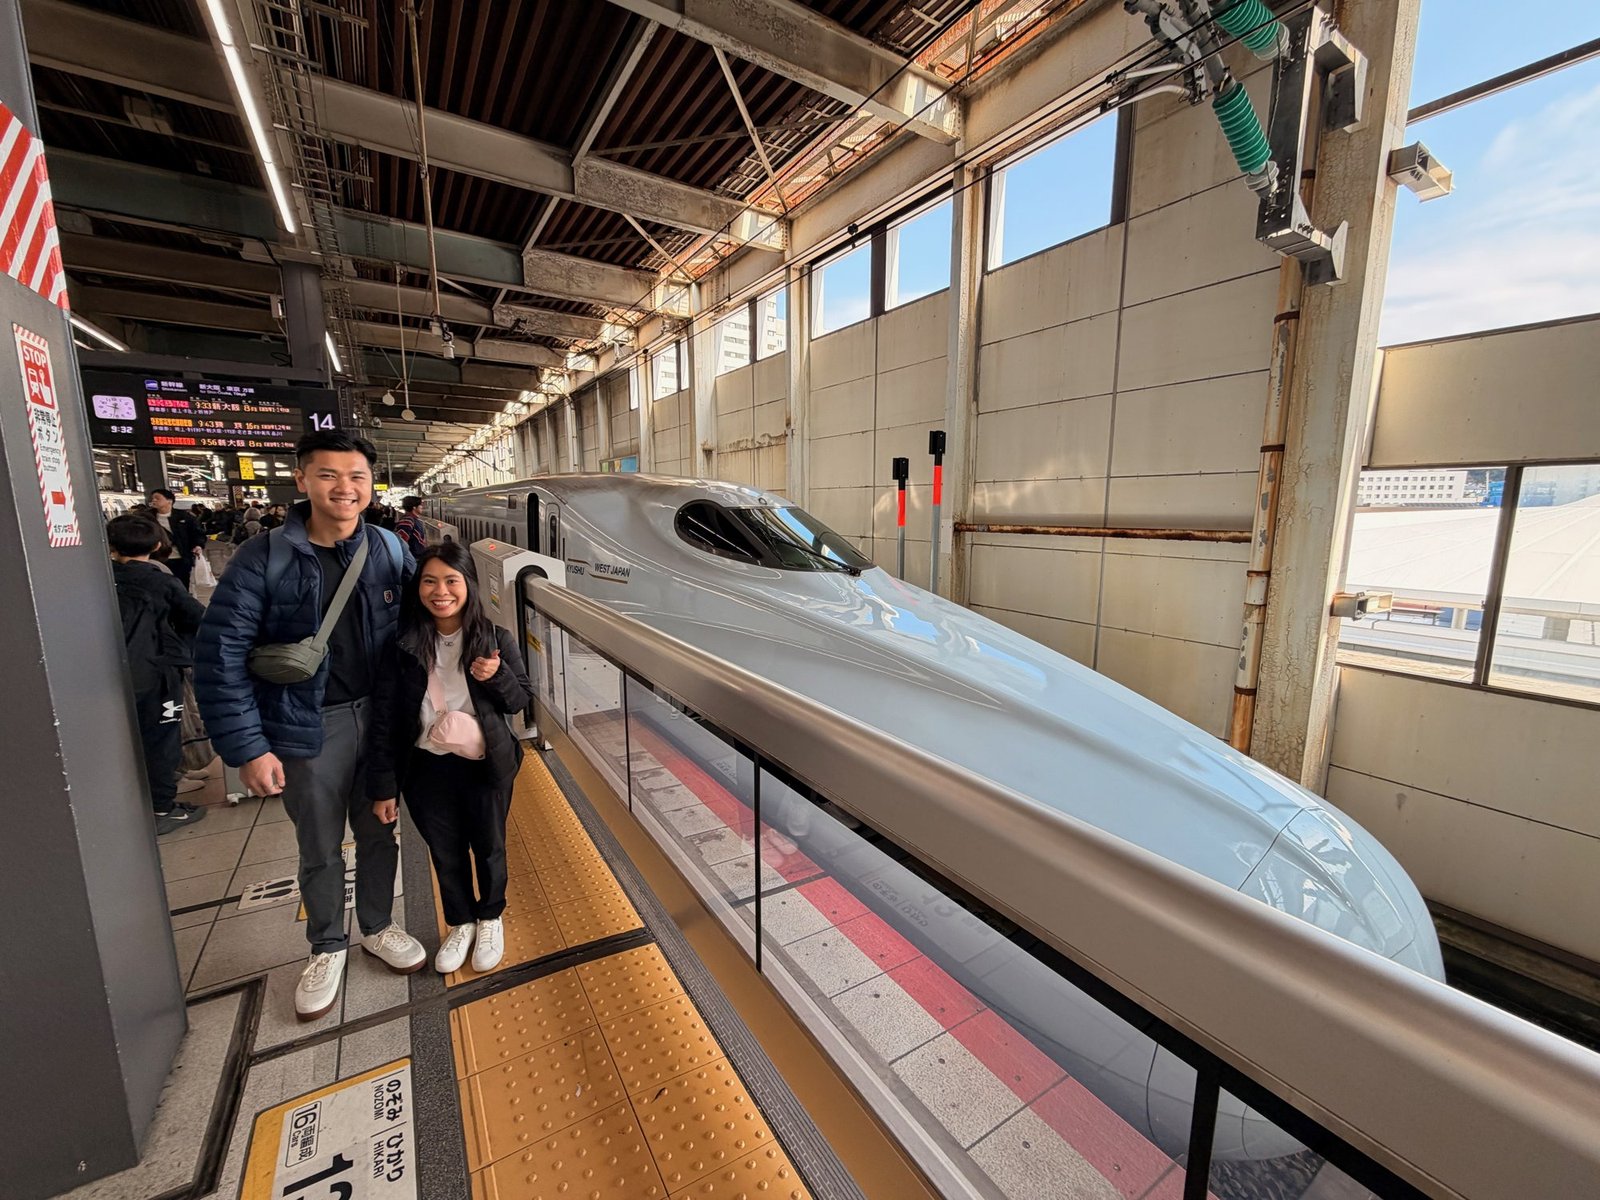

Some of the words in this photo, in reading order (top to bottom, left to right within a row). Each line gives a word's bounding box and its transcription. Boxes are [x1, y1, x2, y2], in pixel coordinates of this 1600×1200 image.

[22, 344, 47, 368] STOP
[110, 425, 133, 434] 9:32
[308, 412, 336, 432] 14
[566, 563, 585, 576] KYUSHU
[594, 562, 611, 575] WEST
[610, 565, 631, 578] JAPAN
[373, 1084, 385, 1121] NOZOMI
[385, 1078, 404, 1122] のぞみ
[290, 1130, 302, 1148] Cars
[373, 1140, 385, 1179] HIKARI
[386, 1132, 404, 1183] ひかり
